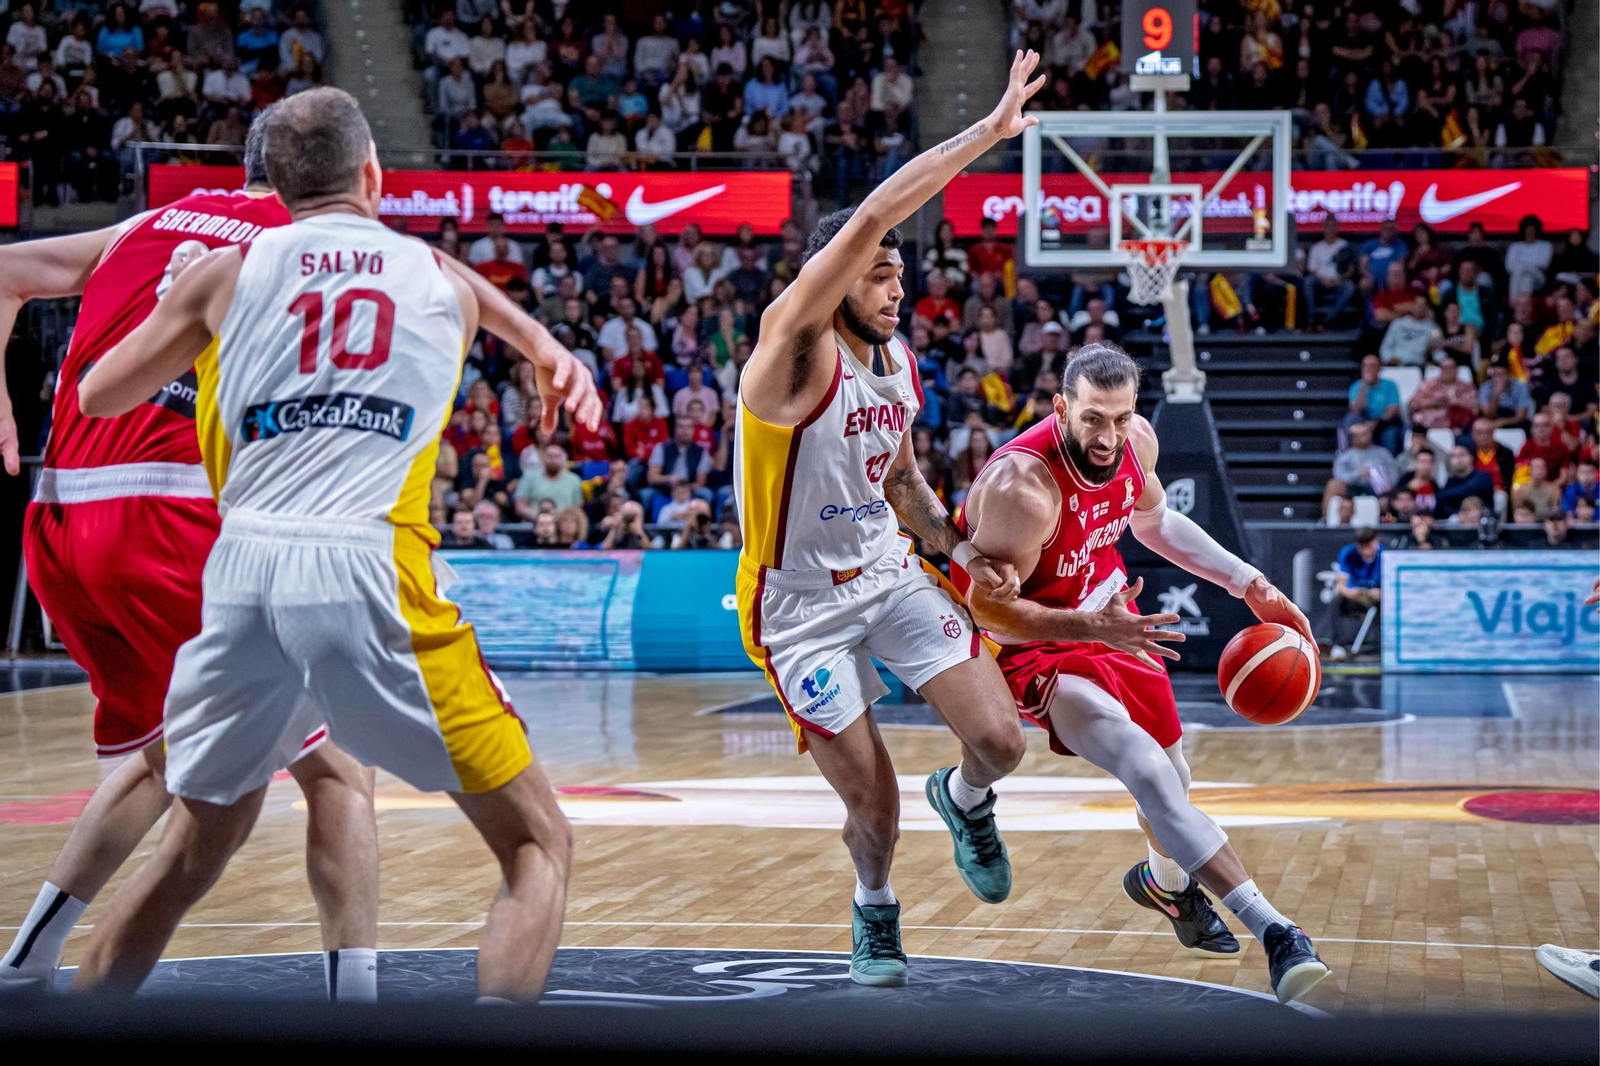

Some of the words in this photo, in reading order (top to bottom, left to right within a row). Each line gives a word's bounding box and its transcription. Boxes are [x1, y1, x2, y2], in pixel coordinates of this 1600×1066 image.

[1142, 7, 1173, 51] 9
[378, 190, 461, 216] aixaBank
[300, 250, 383, 276] SALVÓ
[287, 288, 396, 374] 10
[277, 397, 404, 437] CaixaBank
[844, 402, 908, 438] ESPAÑ
[866, 452, 890, 483] 13
[820, 497, 888, 522] ende
[806, 684, 841, 715] tenerife!
